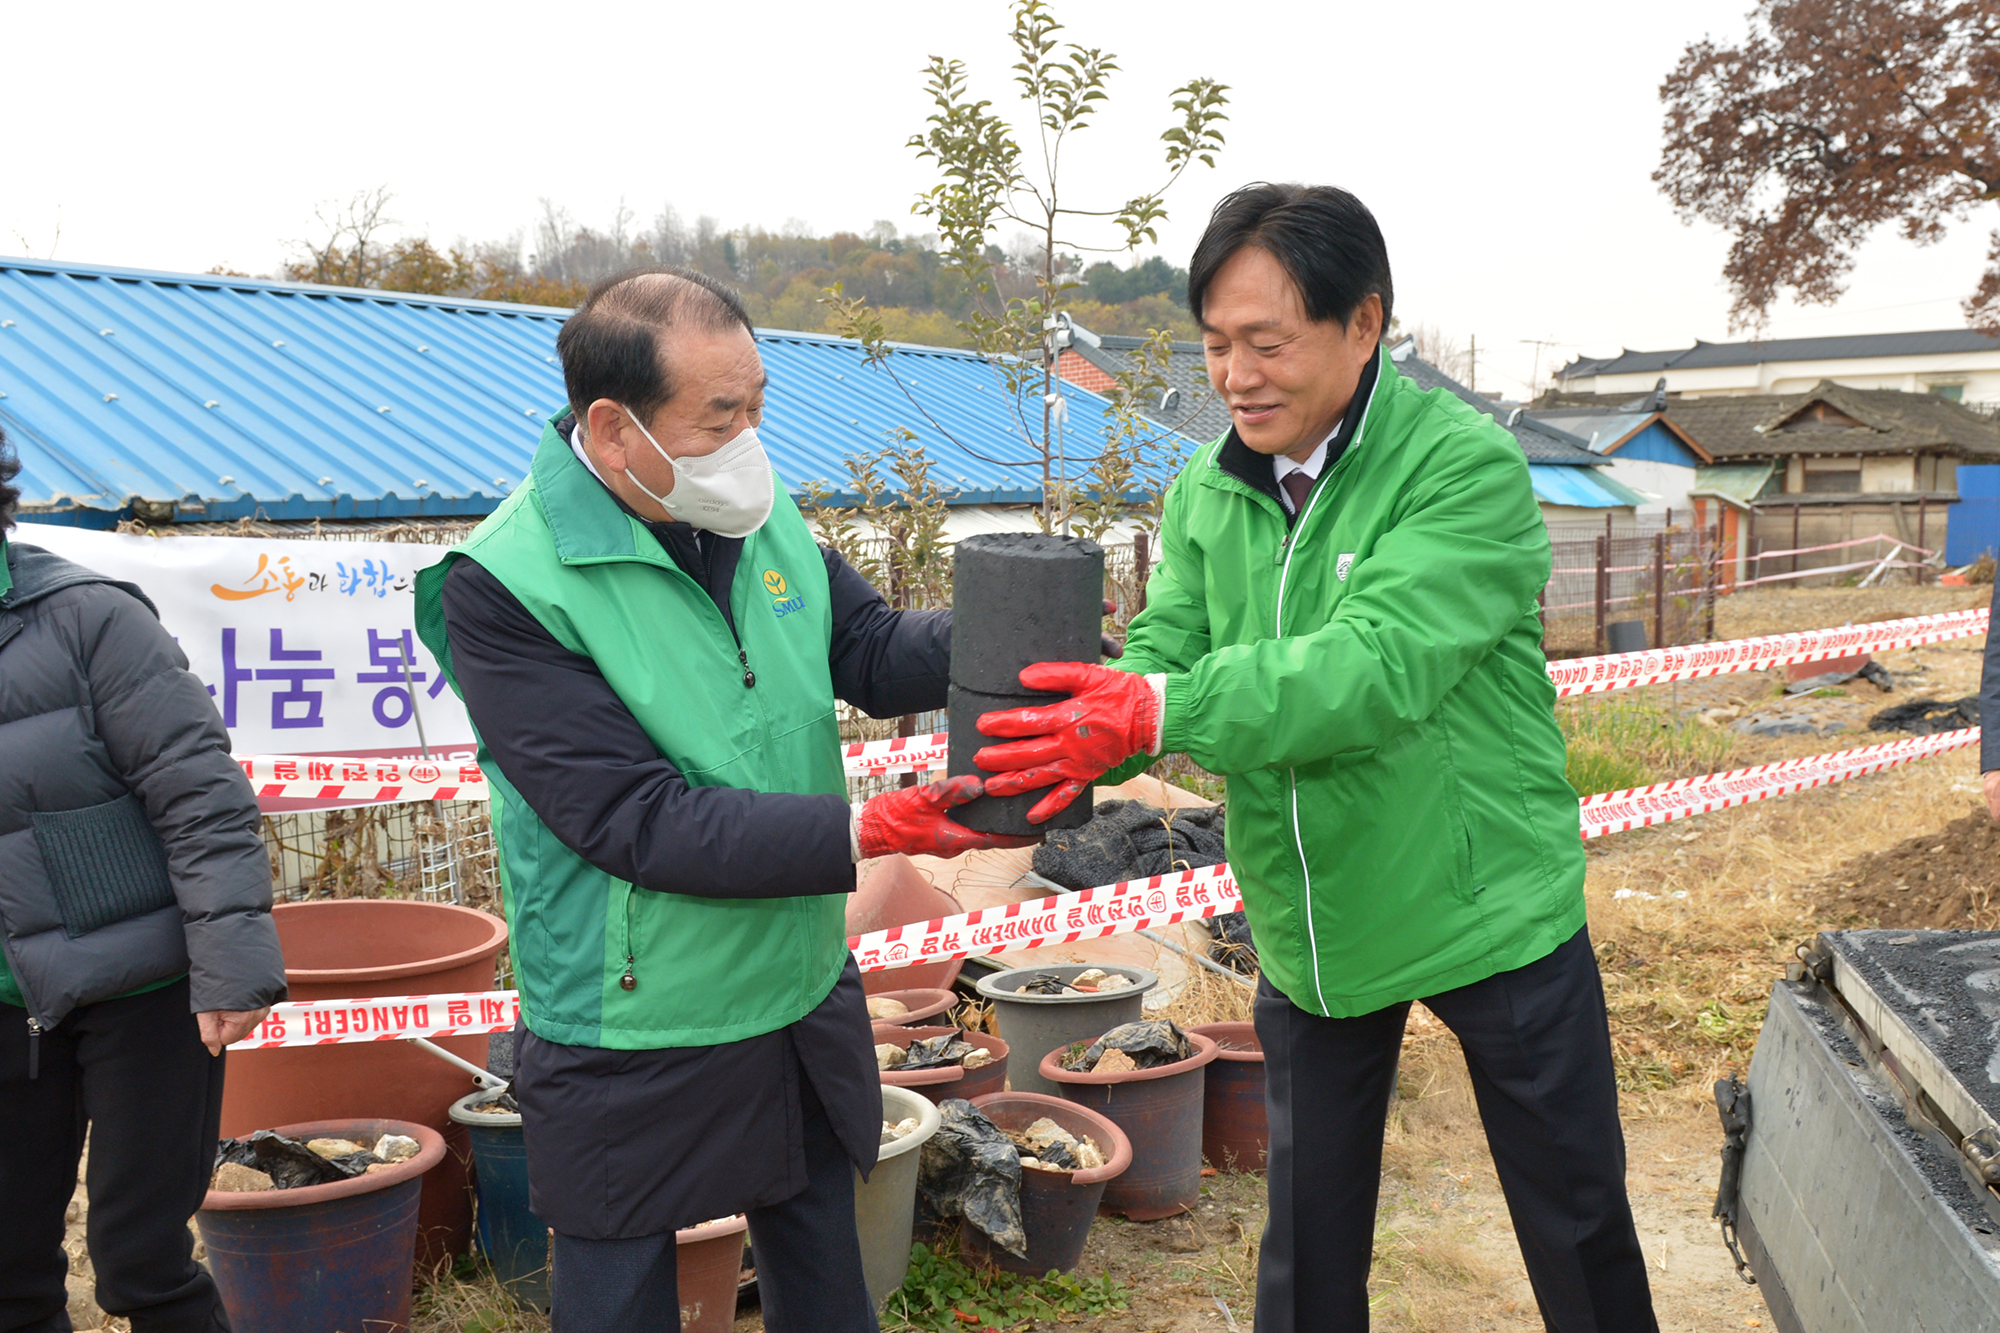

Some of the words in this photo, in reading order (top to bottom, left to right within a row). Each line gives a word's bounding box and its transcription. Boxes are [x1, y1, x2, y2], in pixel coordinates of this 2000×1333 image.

[210, 553, 328, 602] 소통과
[772, 596, 806, 618] SMU
[1661, 654, 1684, 673] 위험
[1690, 648, 1735, 668] DANGER!
[1738, 641, 1782, 663] 안전제일
[357, 628, 447, 729] 봉
[1549, 667, 1588, 687] DANGE
[1591, 659, 1643, 682] 안전제일
[274, 760, 401, 783] 안전제일
[459, 765, 483, 783] 험
[1581, 801, 1637, 826] DANGER!
[1636, 791, 1688, 814] 안전제일
[1175, 883, 1209, 908] 위험
[1066, 895, 1144, 929] 안전제일
[971, 913, 1057, 946] DANGER!
[920, 931, 961, 956] 위험
[303, 1004, 429, 1037] DANGER!
[448, 997, 519, 1027] 제일
[243, 1012, 287, 1041] 위
